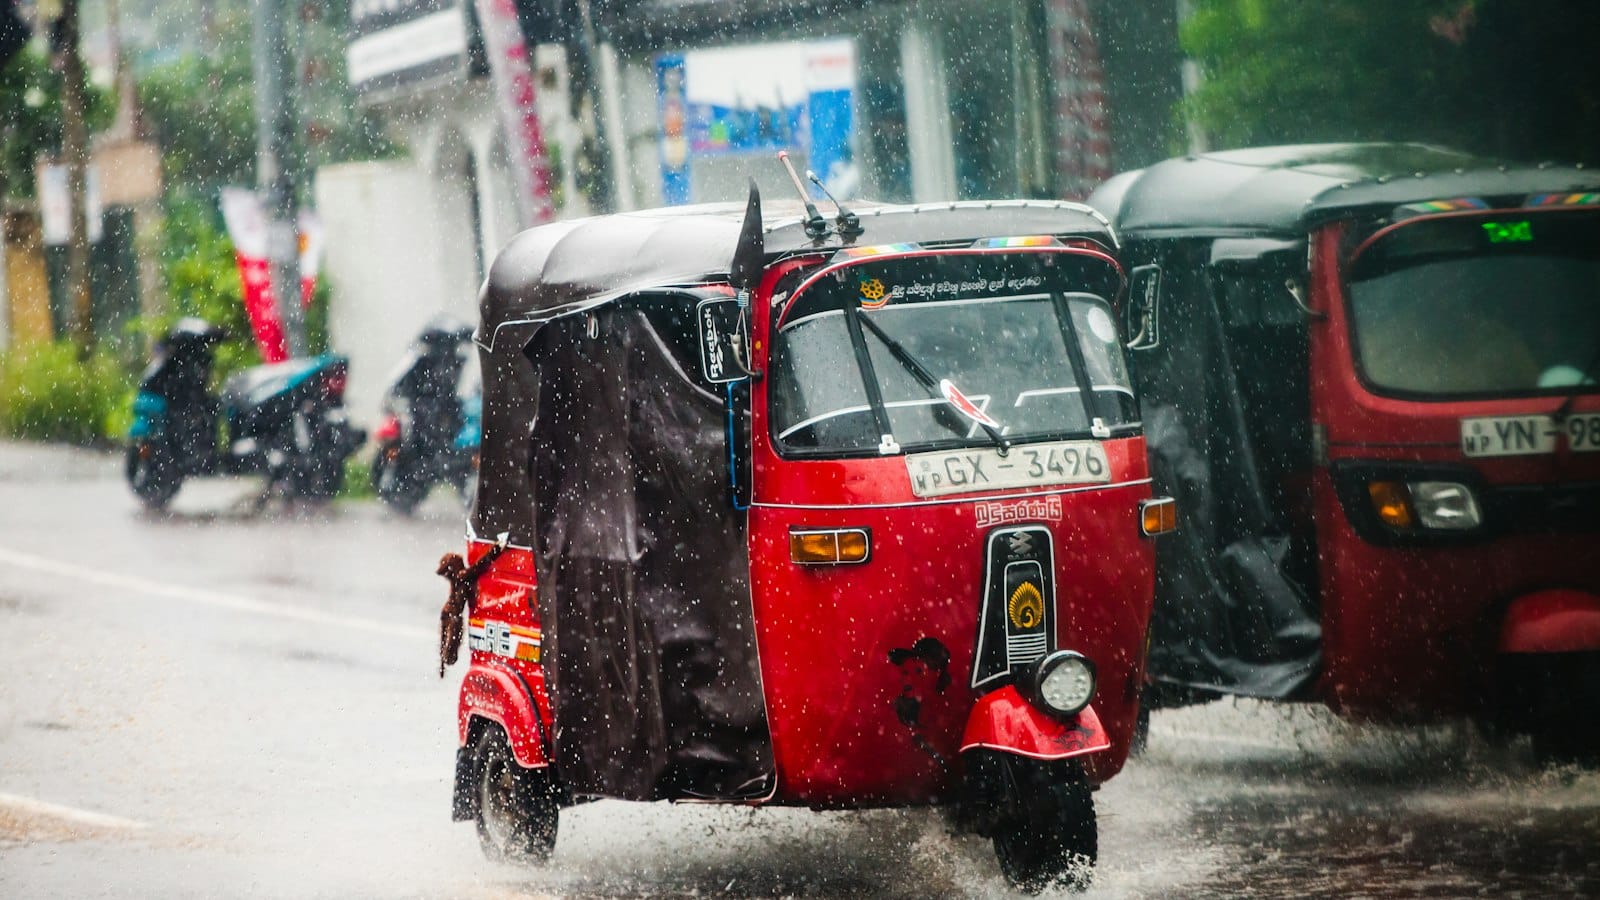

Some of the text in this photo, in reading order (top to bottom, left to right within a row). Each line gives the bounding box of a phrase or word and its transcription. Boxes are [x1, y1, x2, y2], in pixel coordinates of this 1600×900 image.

[704, 307, 719, 378] Reebok
[1494, 419, 1536, 450] YN
[915, 471, 942, 491] WP
[943, 454, 989, 486] GX
[1023, 447, 1102, 479] 3496
